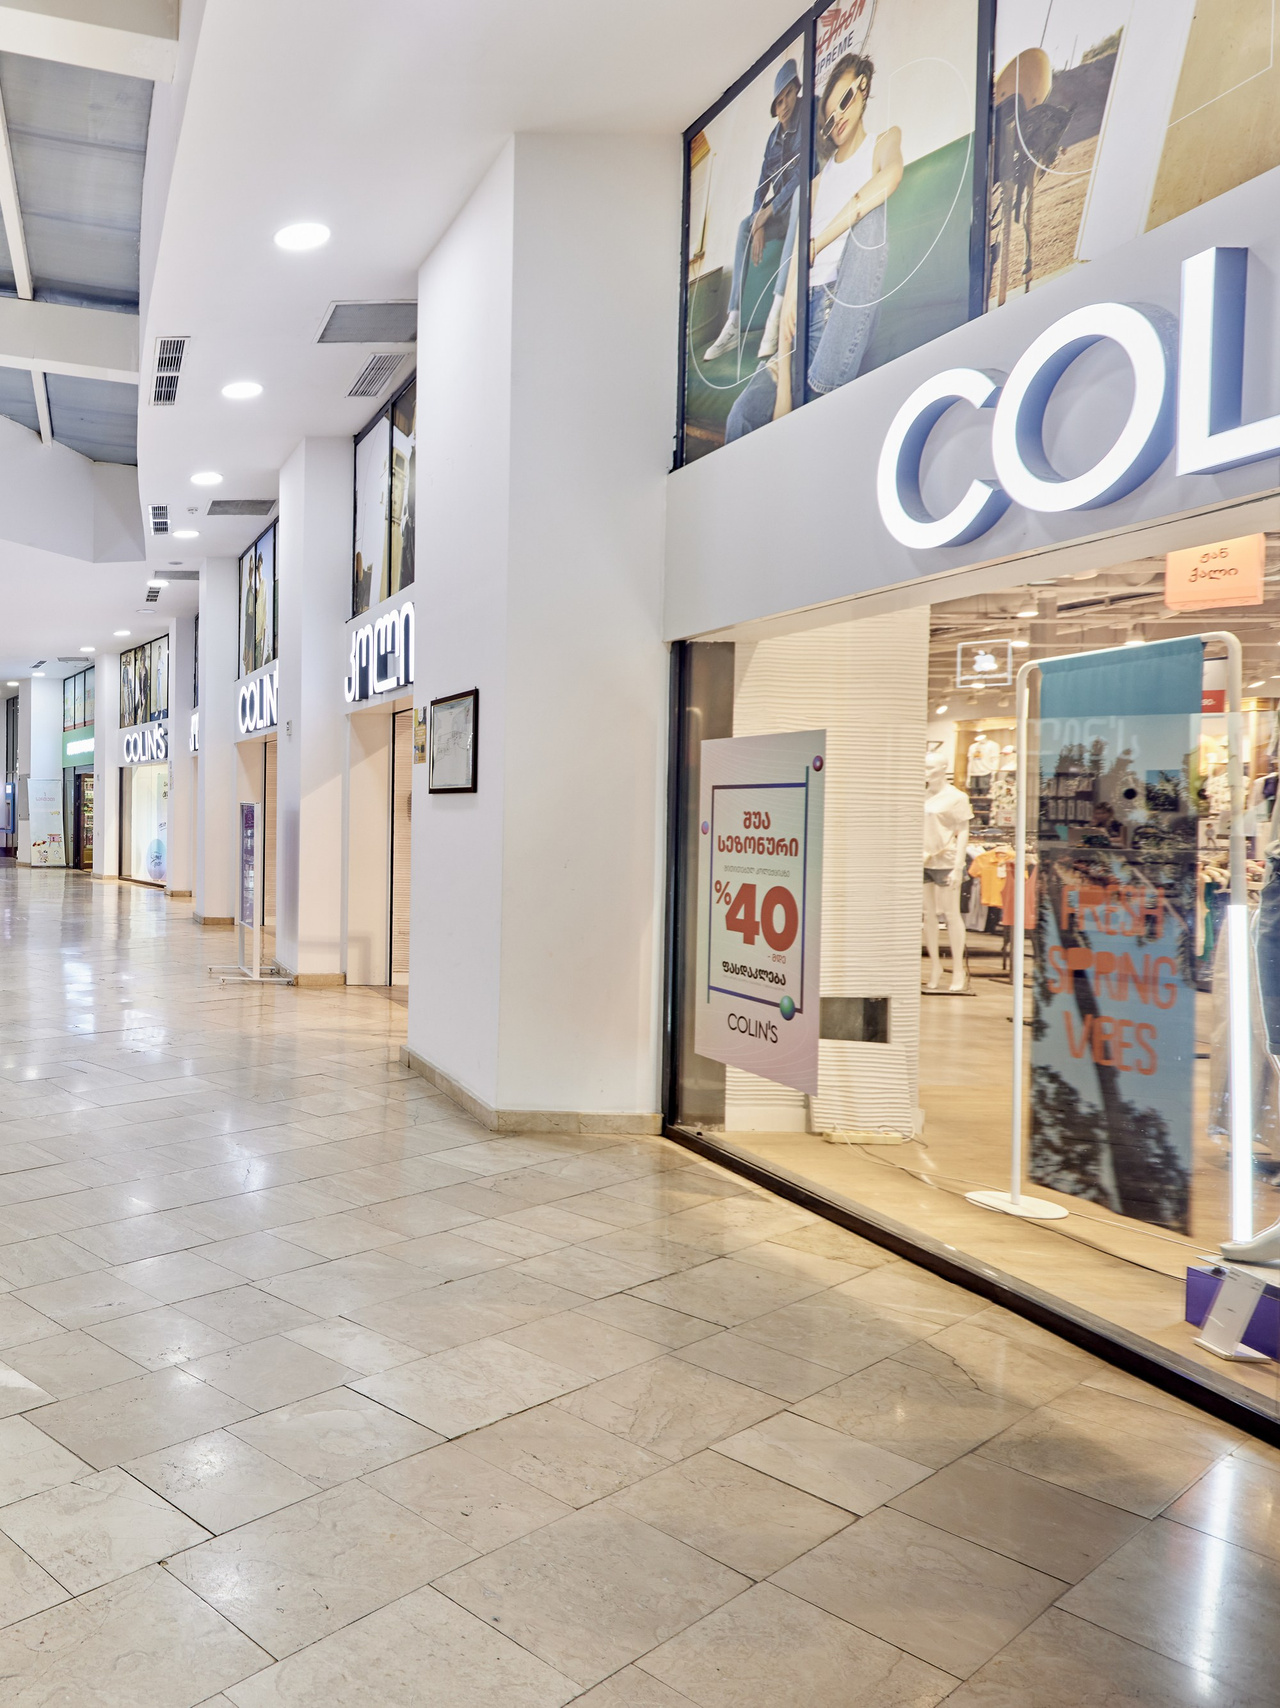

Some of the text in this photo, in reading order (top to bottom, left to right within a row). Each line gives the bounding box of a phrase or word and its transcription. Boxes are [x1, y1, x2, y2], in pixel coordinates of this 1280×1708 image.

[815, 30, 854, 77] UPREME
[124, 722, 166, 763] COLIN'S
[743, 811, 771, 830] შუა
[718, 835, 799, 857] სეზონური
[1061, 884, 1165, 938] FRESH
[722, 960, 787, 986] ფასდაკლება
[1048, 945, 1178, 1010] SPRING
[727, 1012, 778, 1044] COLIN'S
[1063, 1010, 1158, 1076] VIBES
